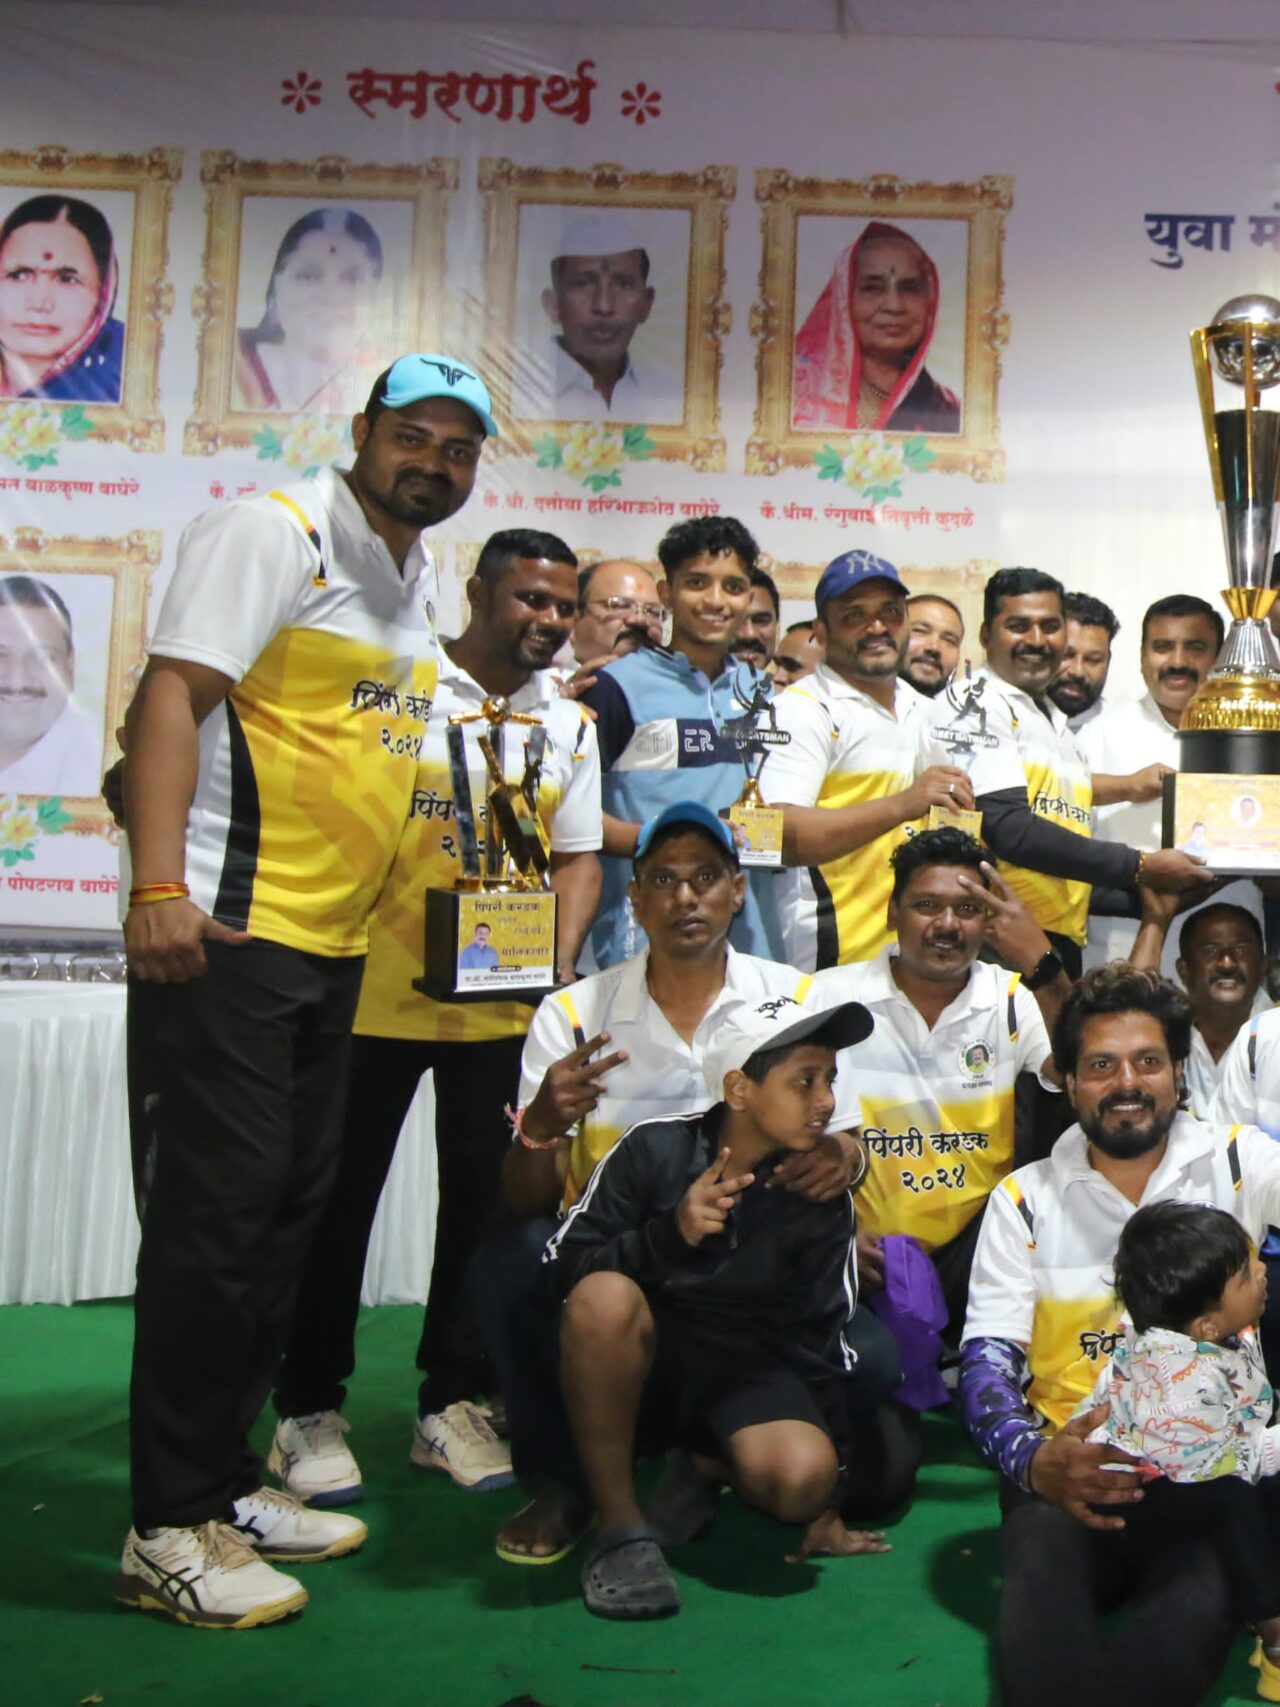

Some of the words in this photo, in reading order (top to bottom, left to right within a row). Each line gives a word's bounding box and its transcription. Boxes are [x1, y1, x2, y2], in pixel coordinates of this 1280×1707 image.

[347, 61, 599, 125] स्मरणार्थ
[1146, 211, 1235, 269] युवा
[8, 871, 76, 892] पोपटराव
[862, 1127, 924, 1158] पिंपरी
[901, 1163, 966, 1192] २०२४
